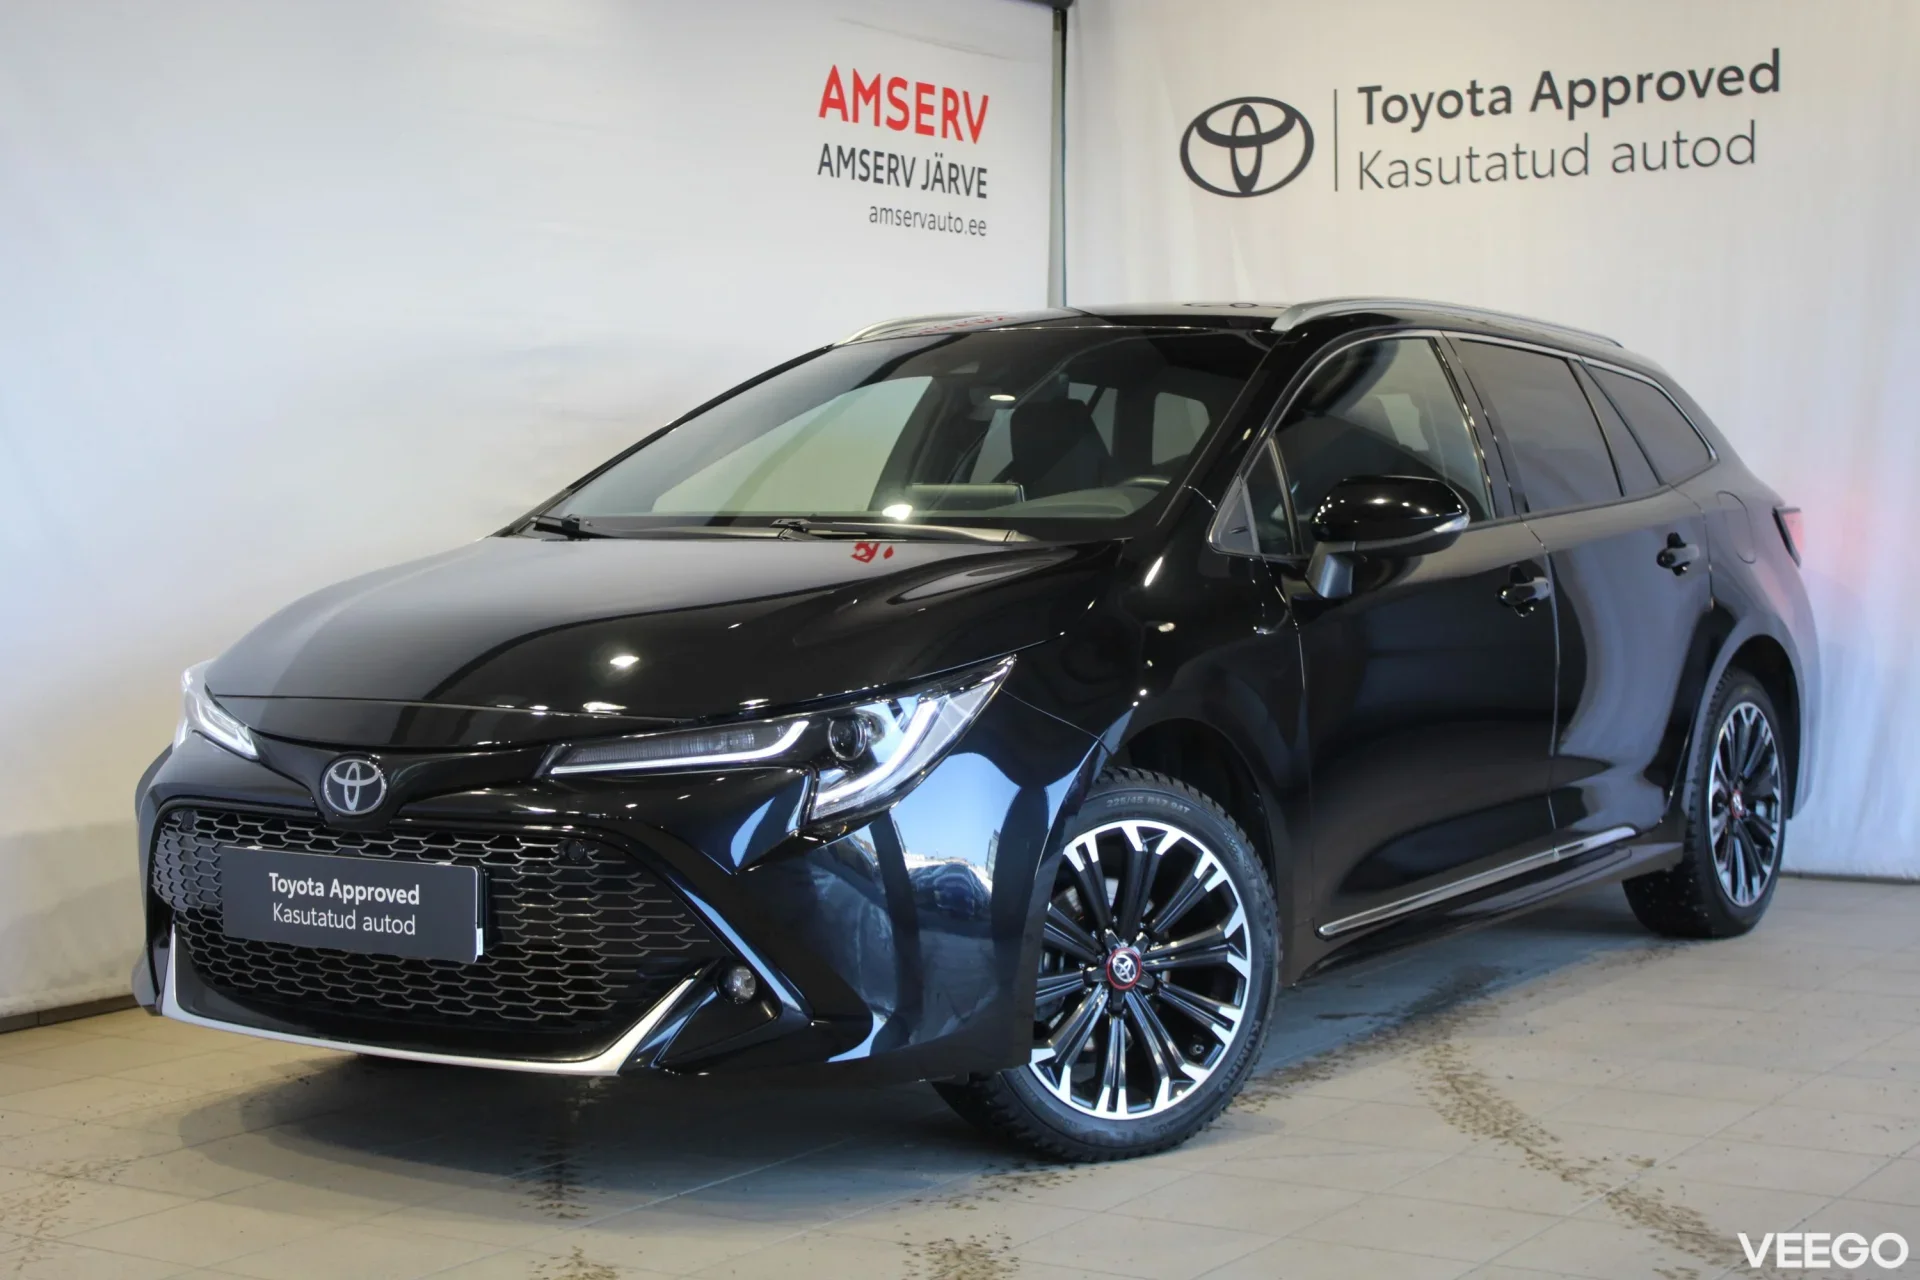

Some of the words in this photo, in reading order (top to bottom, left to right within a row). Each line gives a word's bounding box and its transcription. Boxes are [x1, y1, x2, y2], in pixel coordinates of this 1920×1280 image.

[818, 64, 989, 144] AMSERV
[1358, 80, 1512, 133] Toyota
[1530, 48, 1781, 121] Approved
[817, 143, 917, 189] AMSERV
[920, 151, 988, 200] JÄRVE
[1359, 131, 1589, 191] Kasutatud
[1611, 119, 1756, 174] autod
[868, 205, 987, 237] amservauto.ee
[268, 872, 325, 899] Toyota
[329, 878, 420, 906] Approved
[272, 902, 357, 931] Kasutatud
[362, 913, 416, 936] autod
